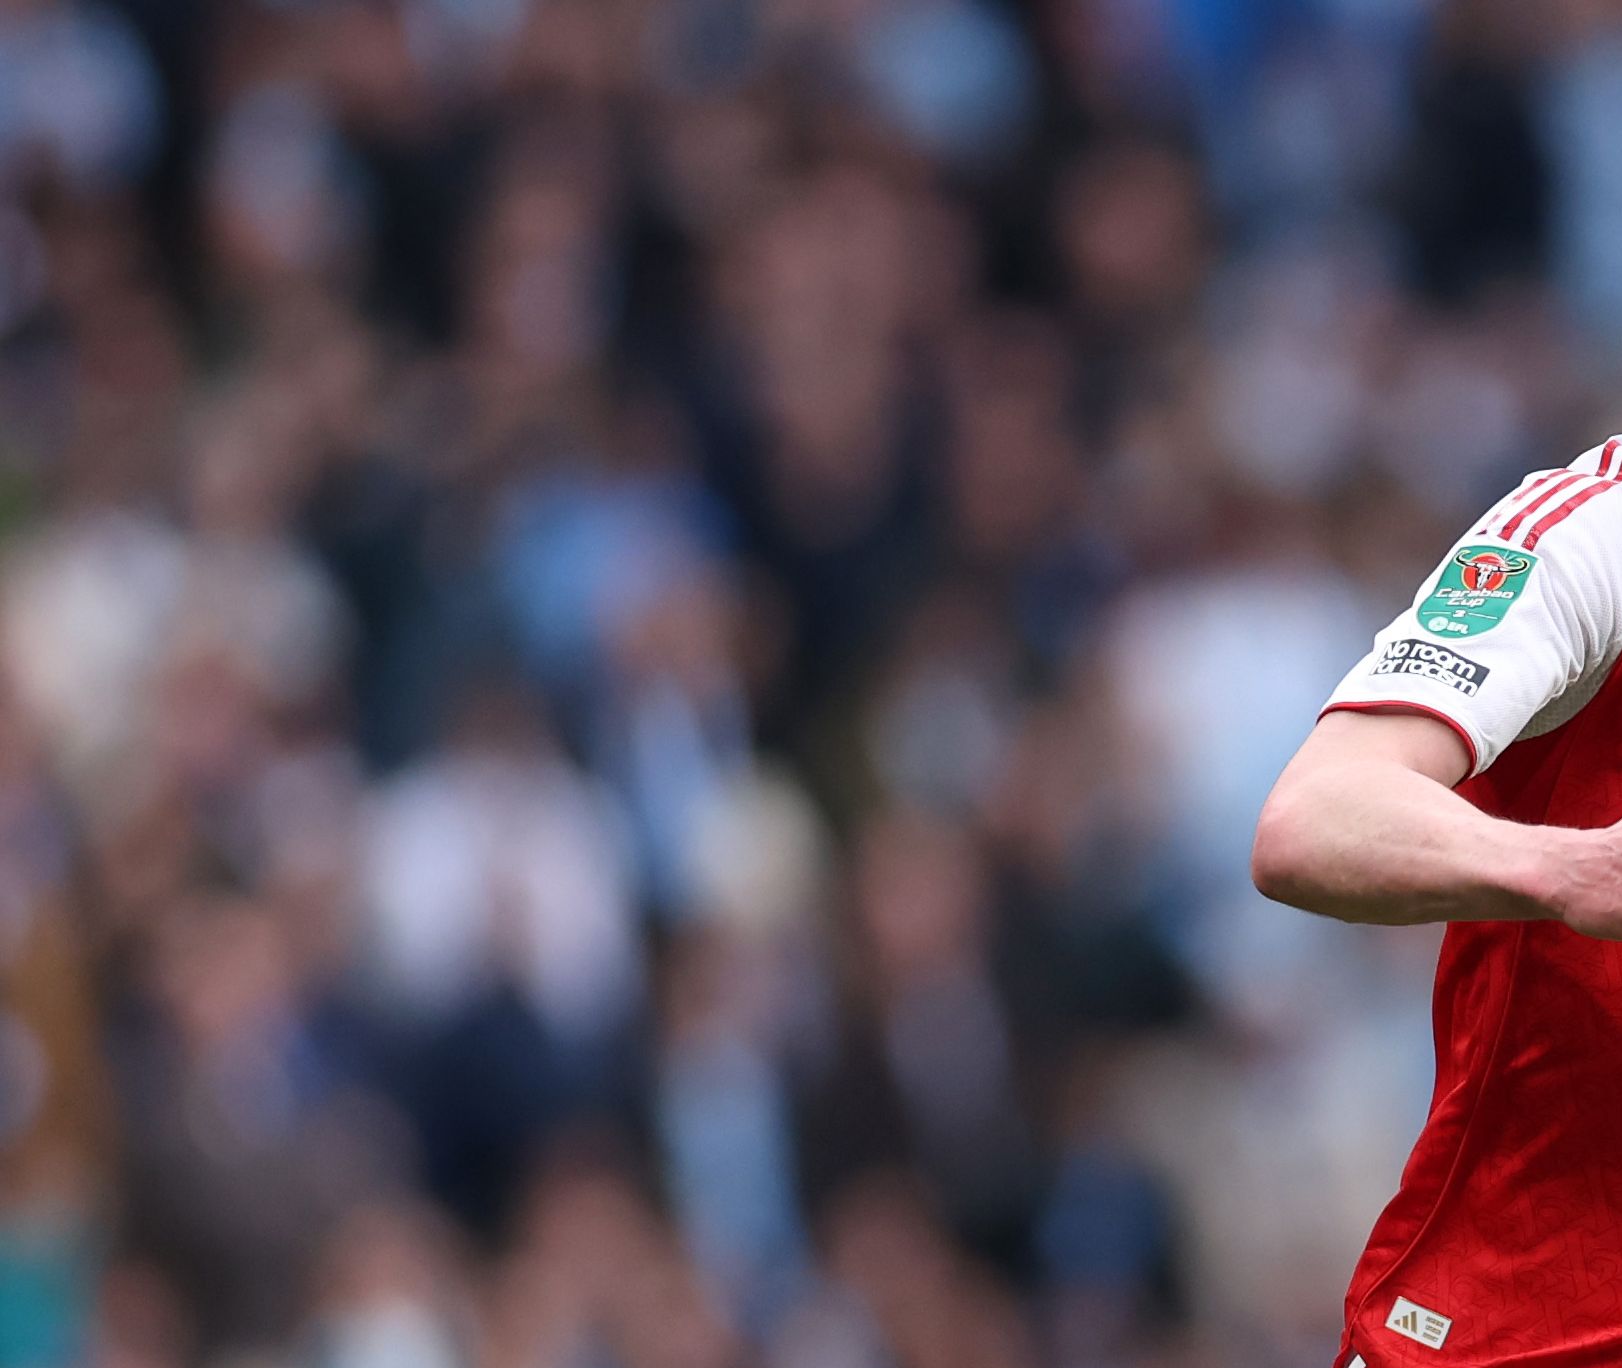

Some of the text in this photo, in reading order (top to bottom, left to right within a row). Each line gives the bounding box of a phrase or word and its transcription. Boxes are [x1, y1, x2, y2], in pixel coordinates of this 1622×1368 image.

[1435, 587, 1515, 600] Carabao
[1447, 597, 1486, 608] Cup
[1383, 639, 1477, 680] No room
[1399, 658, 1478, 697] racism
